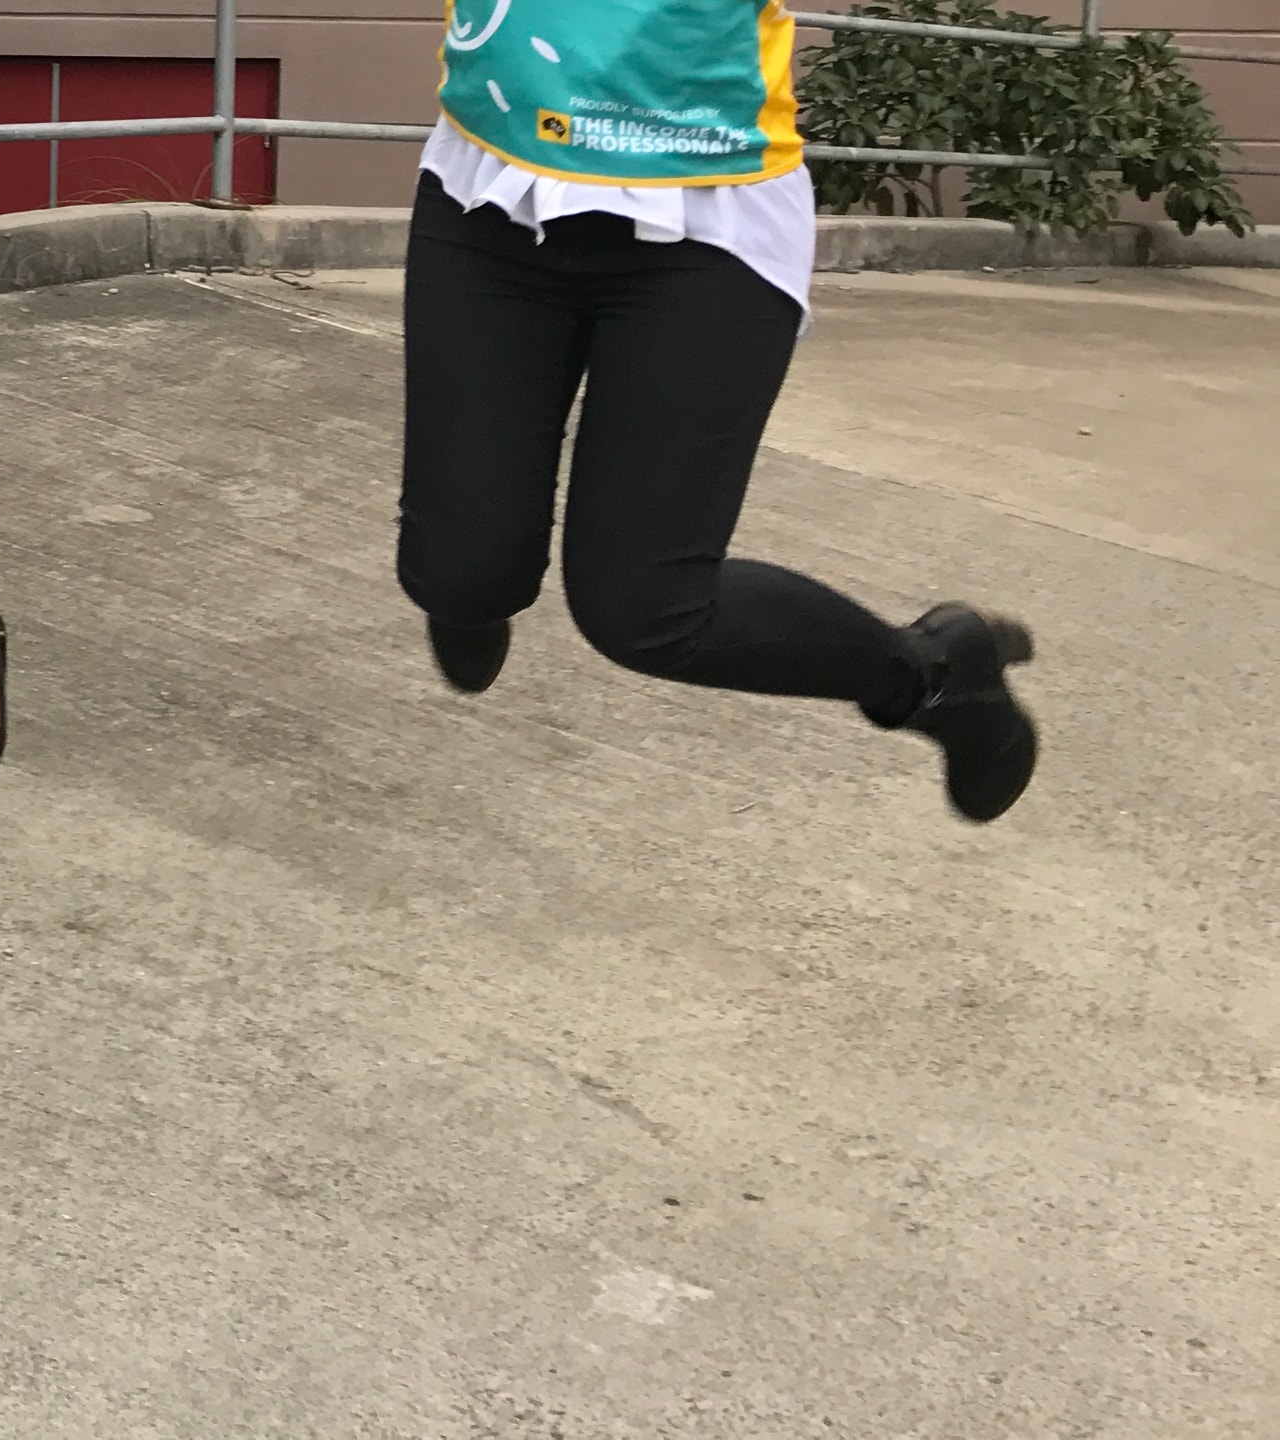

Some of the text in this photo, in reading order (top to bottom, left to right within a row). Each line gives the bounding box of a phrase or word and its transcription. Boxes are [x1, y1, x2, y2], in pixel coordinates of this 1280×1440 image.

[569, 96, 628, 113] PROUDLY
[571, 116, 613, 135] THE
[619, 120, 710, 139] INCOME
